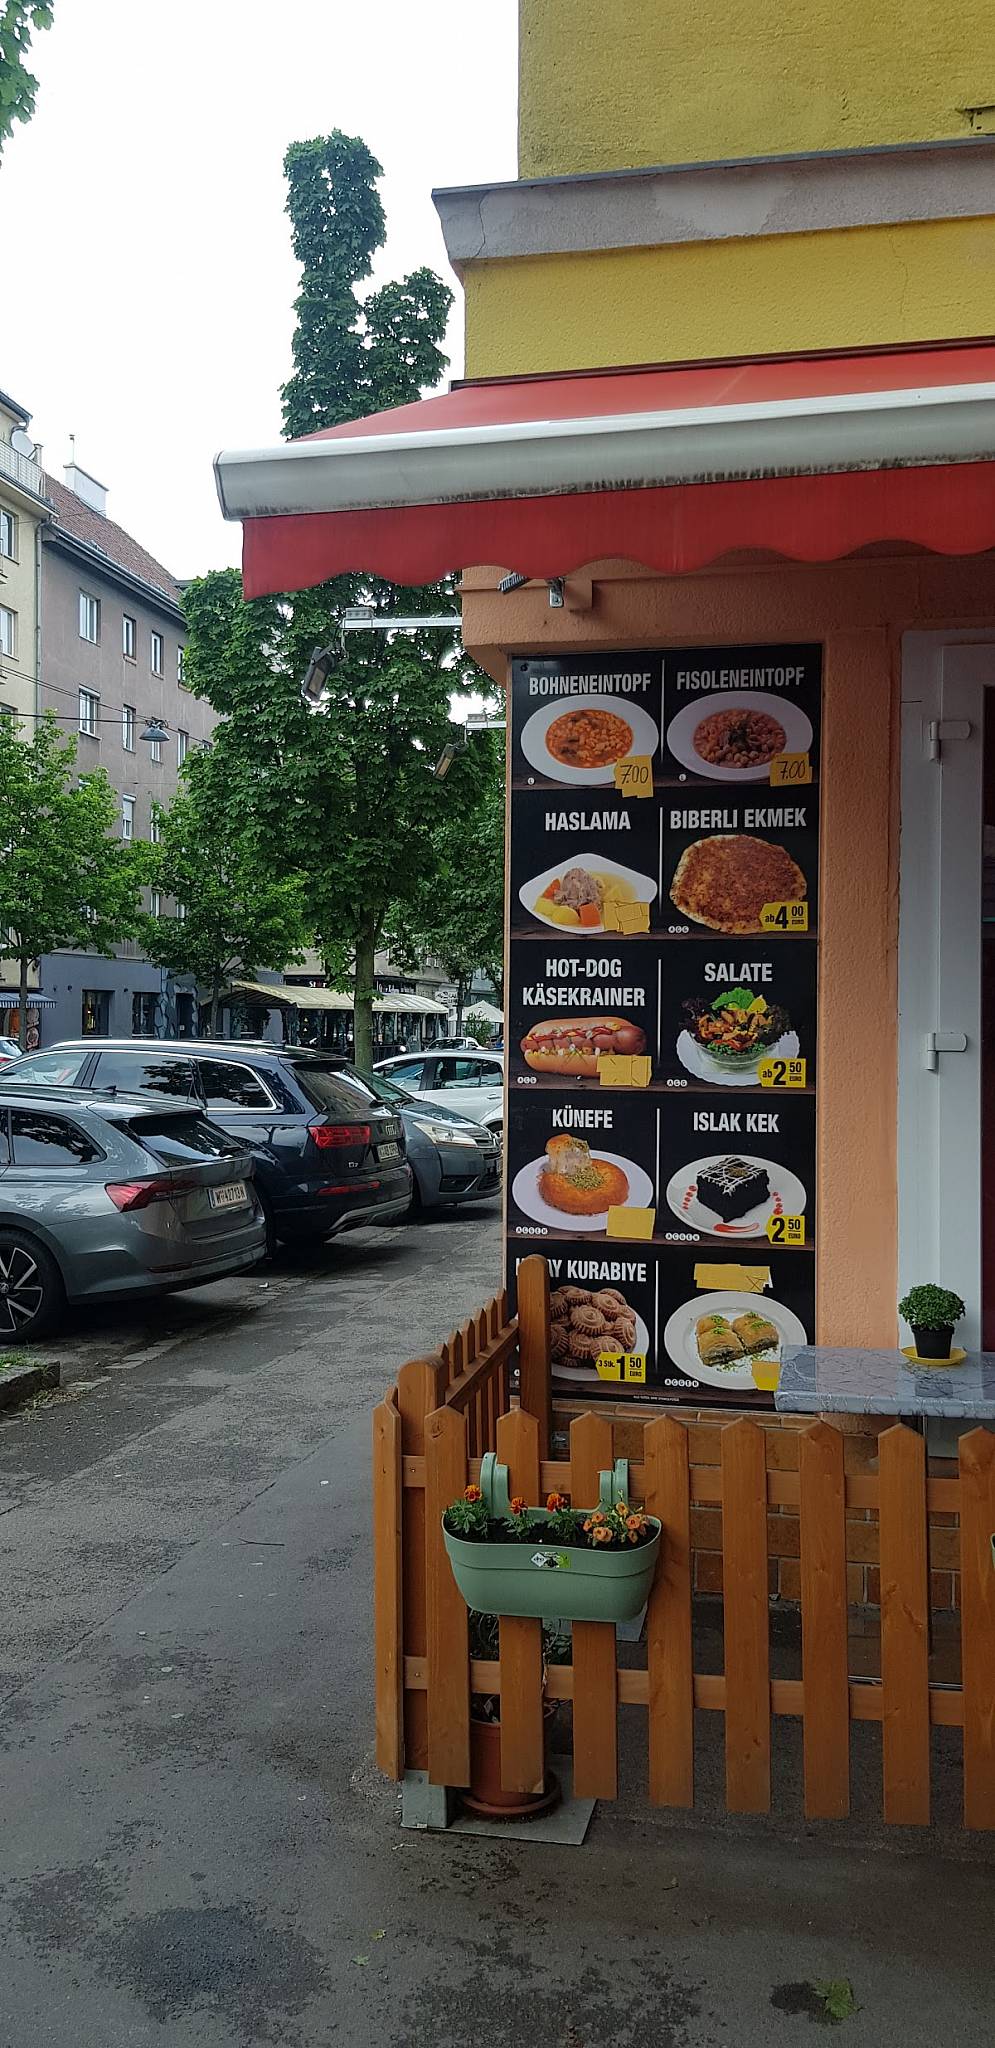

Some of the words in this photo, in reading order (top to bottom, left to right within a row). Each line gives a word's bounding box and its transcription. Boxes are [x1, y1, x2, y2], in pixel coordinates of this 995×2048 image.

[529, 673, 651, 696] BOHNENEINTOPF
[676, 667, 805, 690] FISOLENEINTOPF
[545, 811, 631, 832] HASLAMA
[670, 810, 738, 829] BIBERLI
[744, 808, 807, 828] EKMEK
[765, 915, 775, 923] ab
[775, 907, 788, 929] 4
[791, 906, 804, 917] 00
[546, 959, 622, 978] HOT-DOG
[704, 962, 773, 982] SALATE
[522, 984, 645, 1007] KÄSEKRAINER
[762, 1069, 773, 1079] ab
[773, 1060, 786, 1086] 2
[789, 1062, 802, 1073] 50
[552, 1105, 613, 1129] KÜNEFE
[694, 1112, 743, 1132] ISLAK
[746, 1113, 780, 1133] KEK
[771, 1218, 785, 1243] 2
[788, 1219, 800, 1229] 50
[567, 1260, 647, 1282] KURABIYE
[616, 1355, 625, 1380] 1
[629, 1357, 642, 1368] 50
